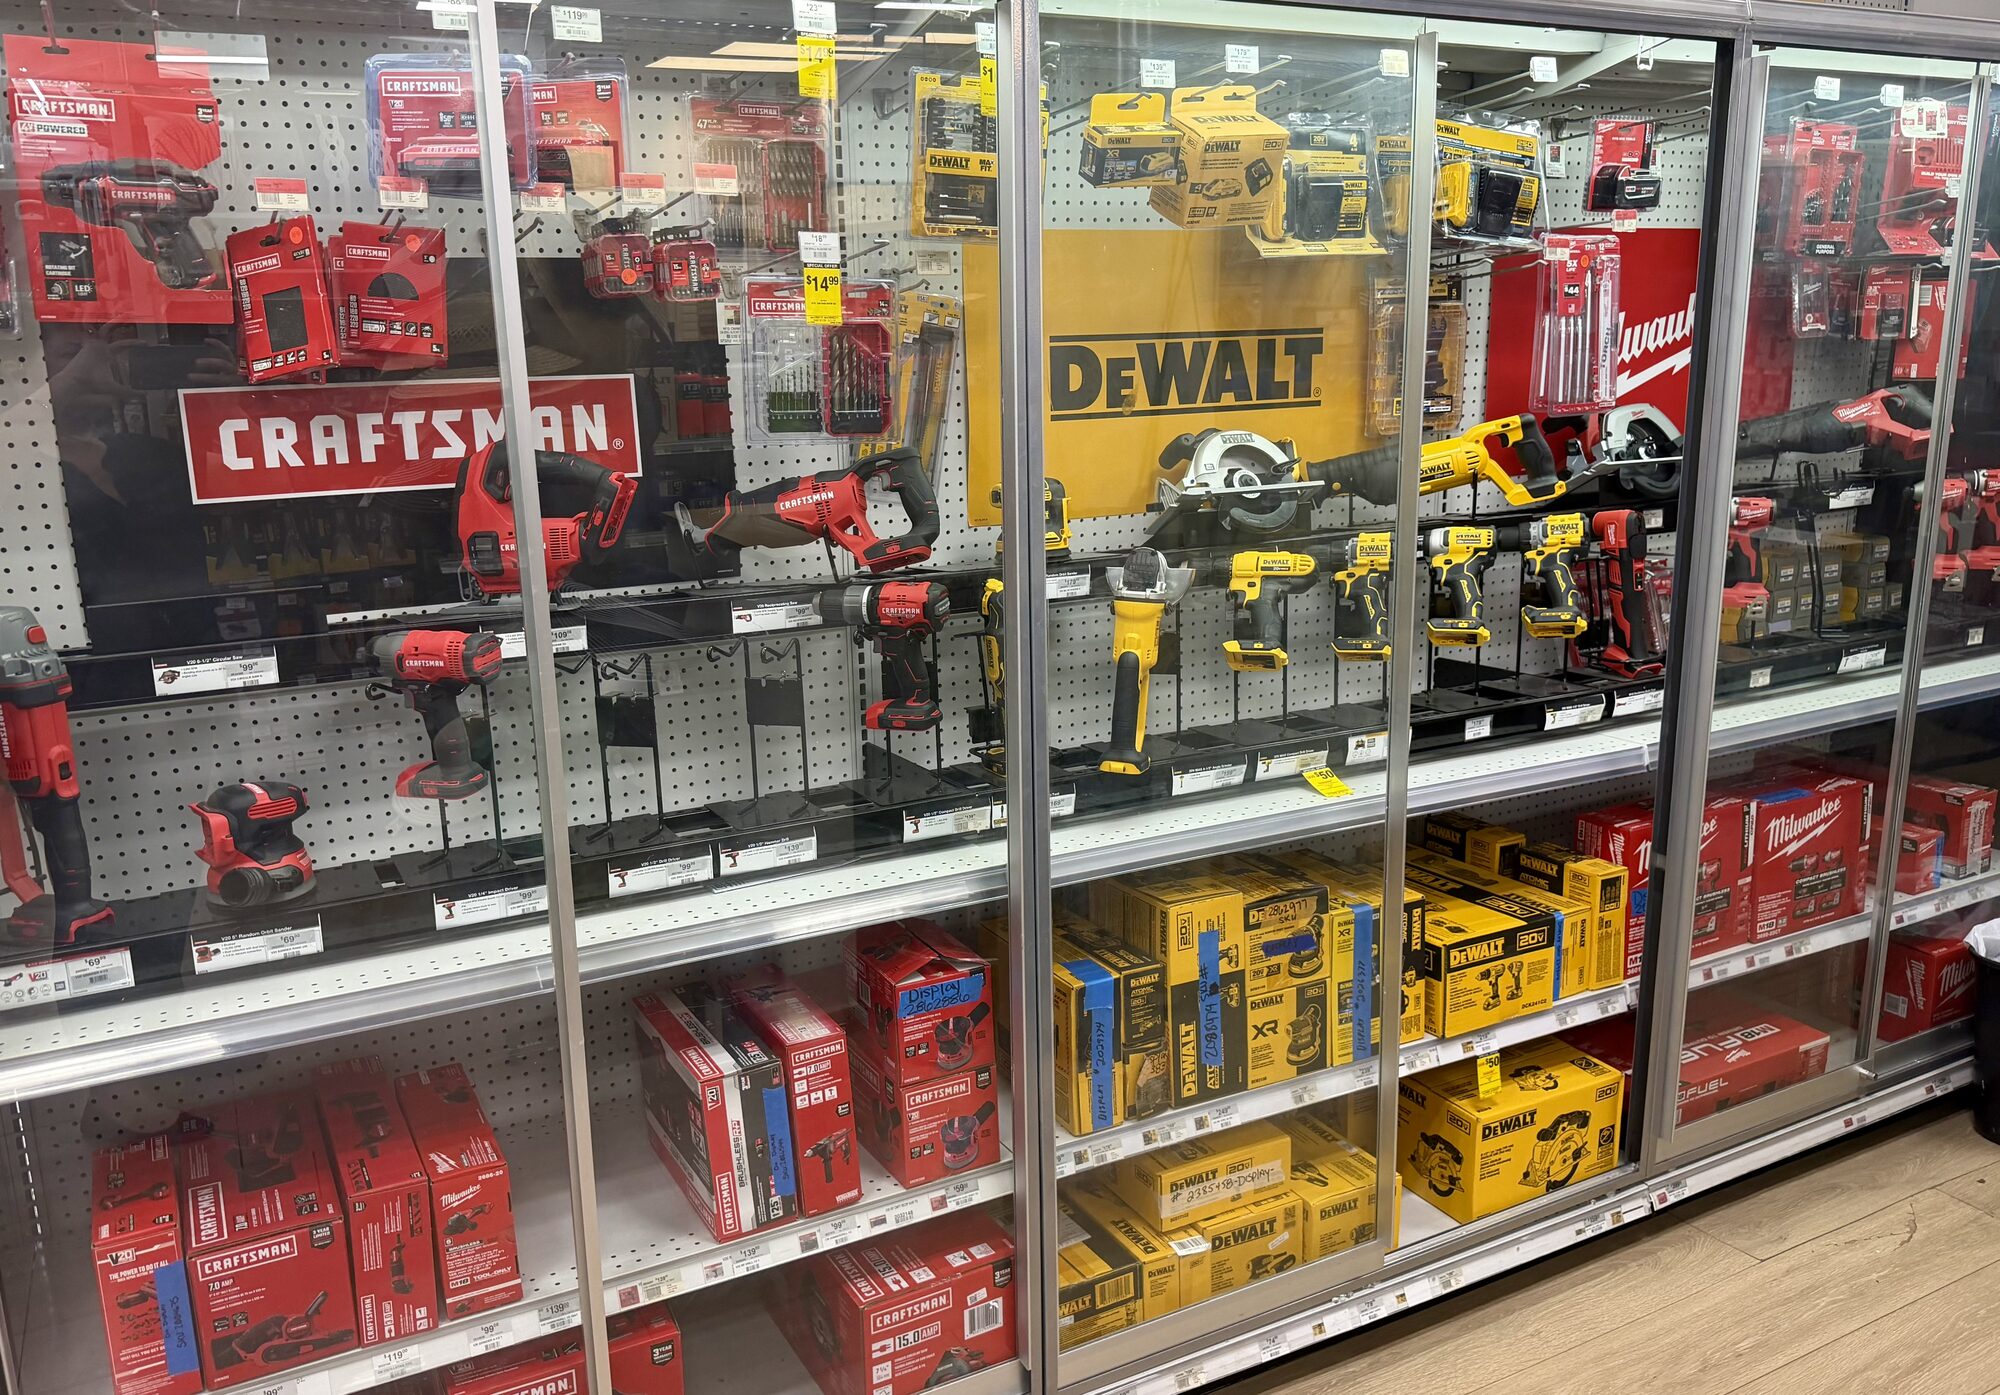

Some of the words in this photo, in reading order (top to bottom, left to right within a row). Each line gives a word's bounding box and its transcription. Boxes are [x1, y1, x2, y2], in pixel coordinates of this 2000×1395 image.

[387, 80, 456, 91] CRAFTSMAN
[21, 99, 111, 116] CRAFTSMAN
[740, 107, 778, 116] CRAFTSMAN
[1193, 115, 1263, 124] DEWALT
[36, 124, 86, 135] POWERED
[1437, 124, 1460, 135] DEWALT
[1107, 137, 1132, 145] DEWALT
[1204, 140, 1241, 152] DEWALT
[1379, 140, 1407, 149] DEWALT
[930, 156, 970, 168] DEWALT
[111, 190, 171, 201] CRAFTSMAN
[348, 248, 388, 257] CRAFTSMAN
[237, 258, 279, 273] CRAFTSMAN
[688, 251, 699, 292] CRAFTSMAN
[75, 284, 90, 293] LED
[1600, 327, 1612, 368] TORCH
[1050, 337, 1323, 412] DEWALT
[1837, 401, 1873, 418] Milwaukee
[1220, 433, 1255, 445] DEWALT
[1421, 462, 1452, 476] DEWALT
[780, 490, 835, 511] CRAFTSMAN
[1550, 523, 1580, 531] DEWALT
[405, 659, 445, 667] CRAFTSMAN
[1315, 770, 1335, 780] $50
[1426, 824, 1461, 842] DEWALT
[1763, 796, 1842, 853] Milwaukee
[1519, 856, 1559, 877] DEWALT
[1519, 873, 1550, 889] ATOMIC
[1795, 874, 1819, 884] COMPACT
[1819, 867, 1847, 879] BRUSHLESS
[1278, 914, 1297, 924] SKU
[1338, 930, 1351, 938] XR
[1450, 938, 1505, 968] DEWALT
[1519, 931, 1545, 946] 20V
[1130, 973, 1160, 988] DEWALT
[1911, 958, 1926, 1010] Milwaukee
[908, 980, 961, 1003] Display
[1250, 994, 1284, 1010] DEWALT
[1251, 1019, 1279, 1041] XR
[795, 1043, 841, 1062] CRAFTSMAN
[1180, 1023, 1197, 1098] DEWALT
[807, 1064, 819, 1075] 7.0
[909, 1084, 967, 1106] CRAFTSMAN
[1597, 1085, 1618, 1099] 20V
[1449, 1114, 1469, 1132] 20V
[1481, 1111, 1537, 1142] DEWALT
[733, 1137, 746, 1188] BRUSHLESS
[1170, 1168, 1218, 1194] DEWALT
[1228, 1160, 1251, 1173] 20V
[440, 1184, 482, 1207] Milwaukee
[718, 1176, 736, 1230] CRAFTSMAN
[198, 1186, 218, 1242] CRAFTSMAN
[1320, 1197, 1359, 1220] DEWALT
[1211, 1218, 1277, 1252] DEWALT
[107, 1250, 134, 1265] V20
[204, 1243, 291, 1274] CRAFTSMAN
[108, 1272, 117, 1280] THE
[117, 1268, 138, 1279] POWER
[138, 1265, 146, 1273] TO
[159, 1259, 169, 1268] ALL
[450, 1277, 469, 1288] M18
[473, 1266, 512, 1281] TOOL-ONLY
[835, 1254, 876, 1297] CRAFTSMAN
[994, 1271, 1000, 1280] 3
[999, 1267, 1011, 1276] YEAR
[1147, 1264, 1176, 1279] DEWALT
[208, 1281, 221, 1292] 7.0
[221, 1278, 234, 1288] AMP
[365, 1297, 375, 1341] CRAFTSMAN
[875, 1294, 948, 1328] CRAFTSMAN
[896, 1330, 920, 1349] 15.0
[920, 1323, 940, 1340] AMP
[653, 1347, 659, 1356] 3
[659, 1344, 673, 1353] YEAR
